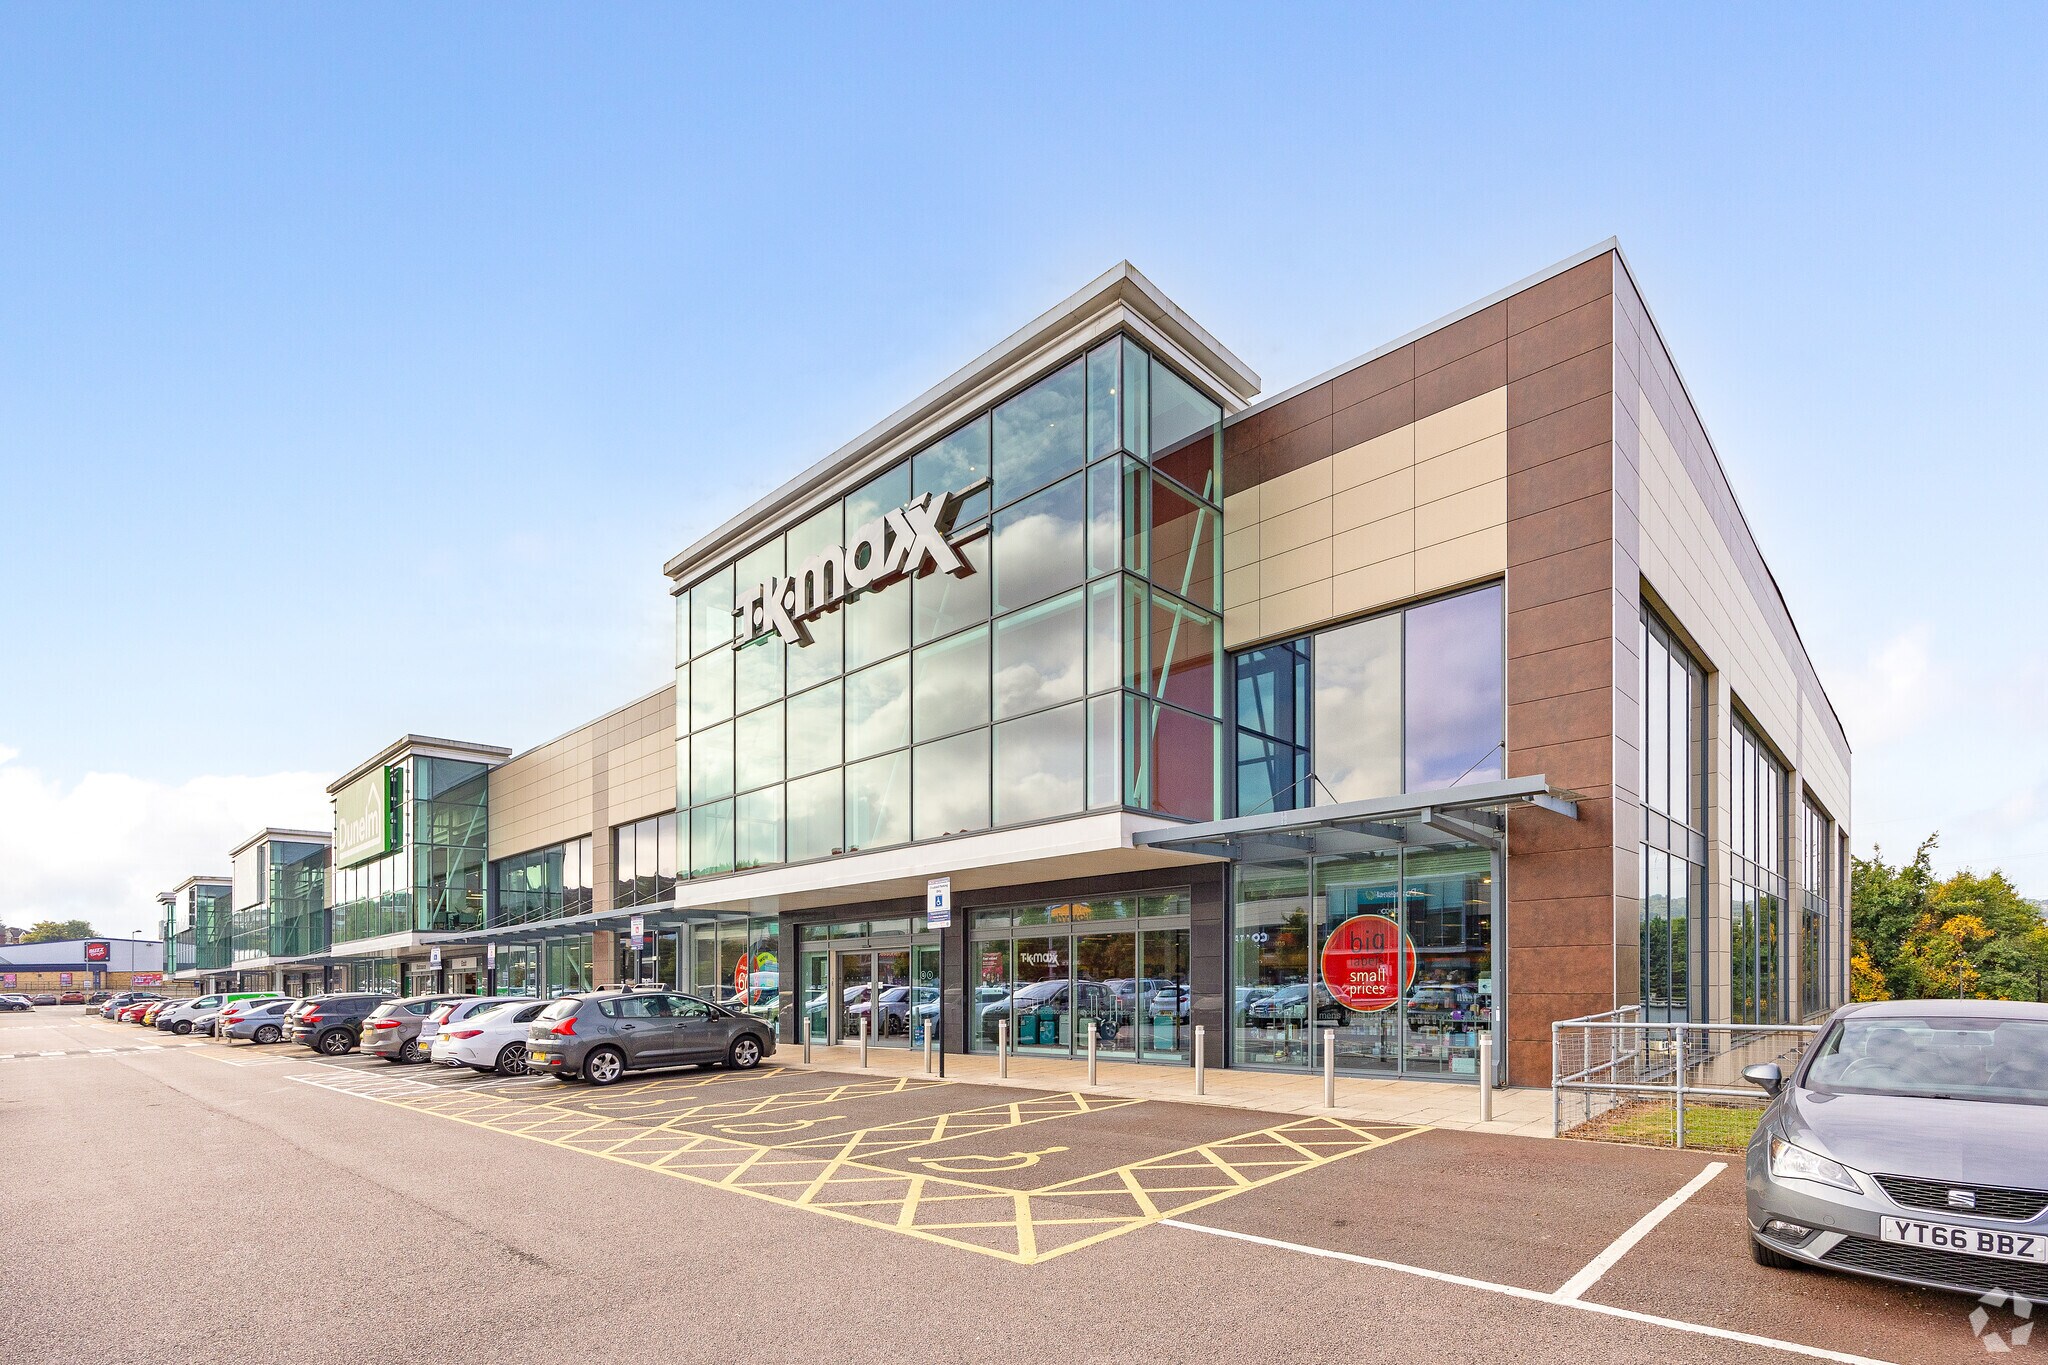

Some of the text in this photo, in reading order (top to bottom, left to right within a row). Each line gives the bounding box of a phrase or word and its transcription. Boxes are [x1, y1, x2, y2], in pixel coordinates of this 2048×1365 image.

[339, 806, 379, 851] Dunelm
[1350, 930, 1385, 954] big
[1350, 955, 1385, 967] labels
[1350, 968, 1386, 982] small
[1350, 982, 1386, 998] prices
[1895, 1221, 2035, 1258] YT66 BBZ
